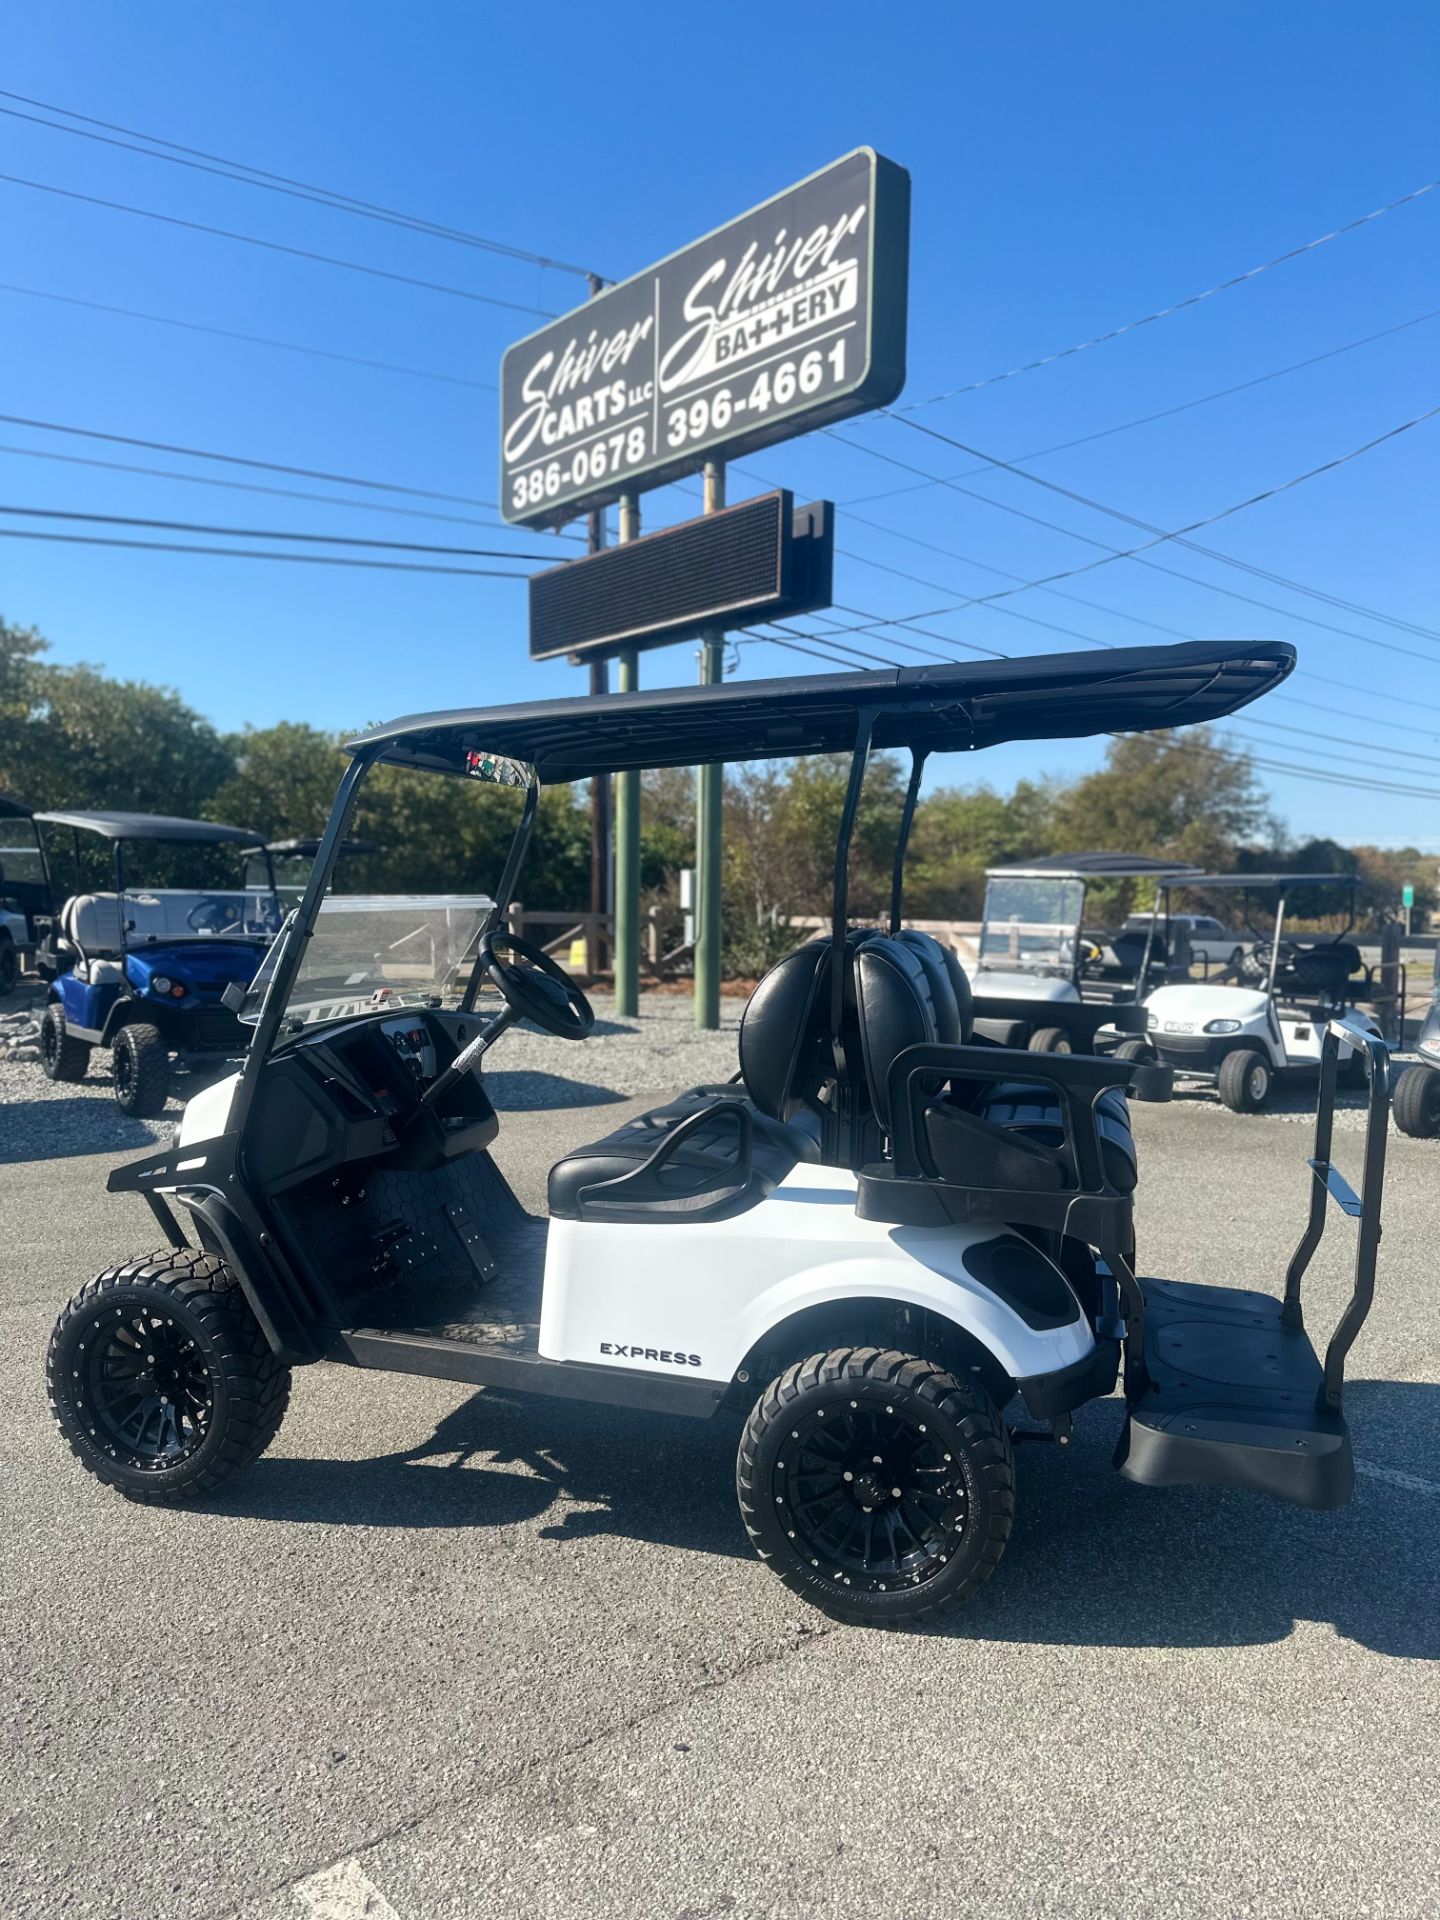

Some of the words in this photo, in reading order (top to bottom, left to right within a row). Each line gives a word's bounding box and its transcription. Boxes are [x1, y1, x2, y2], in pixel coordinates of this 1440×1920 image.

[659, 204, 866, 393] Shiver
[504, 316, 653, 463] Shiver
[541, 379, 626, 445] CARTS
[628, 381, 653, 407] LLC
[667, 338, 845, 447] 396-4661
[512, 426, 645, 508] 386-0678
[600, 1342, 702, 1367] EXPRESS
